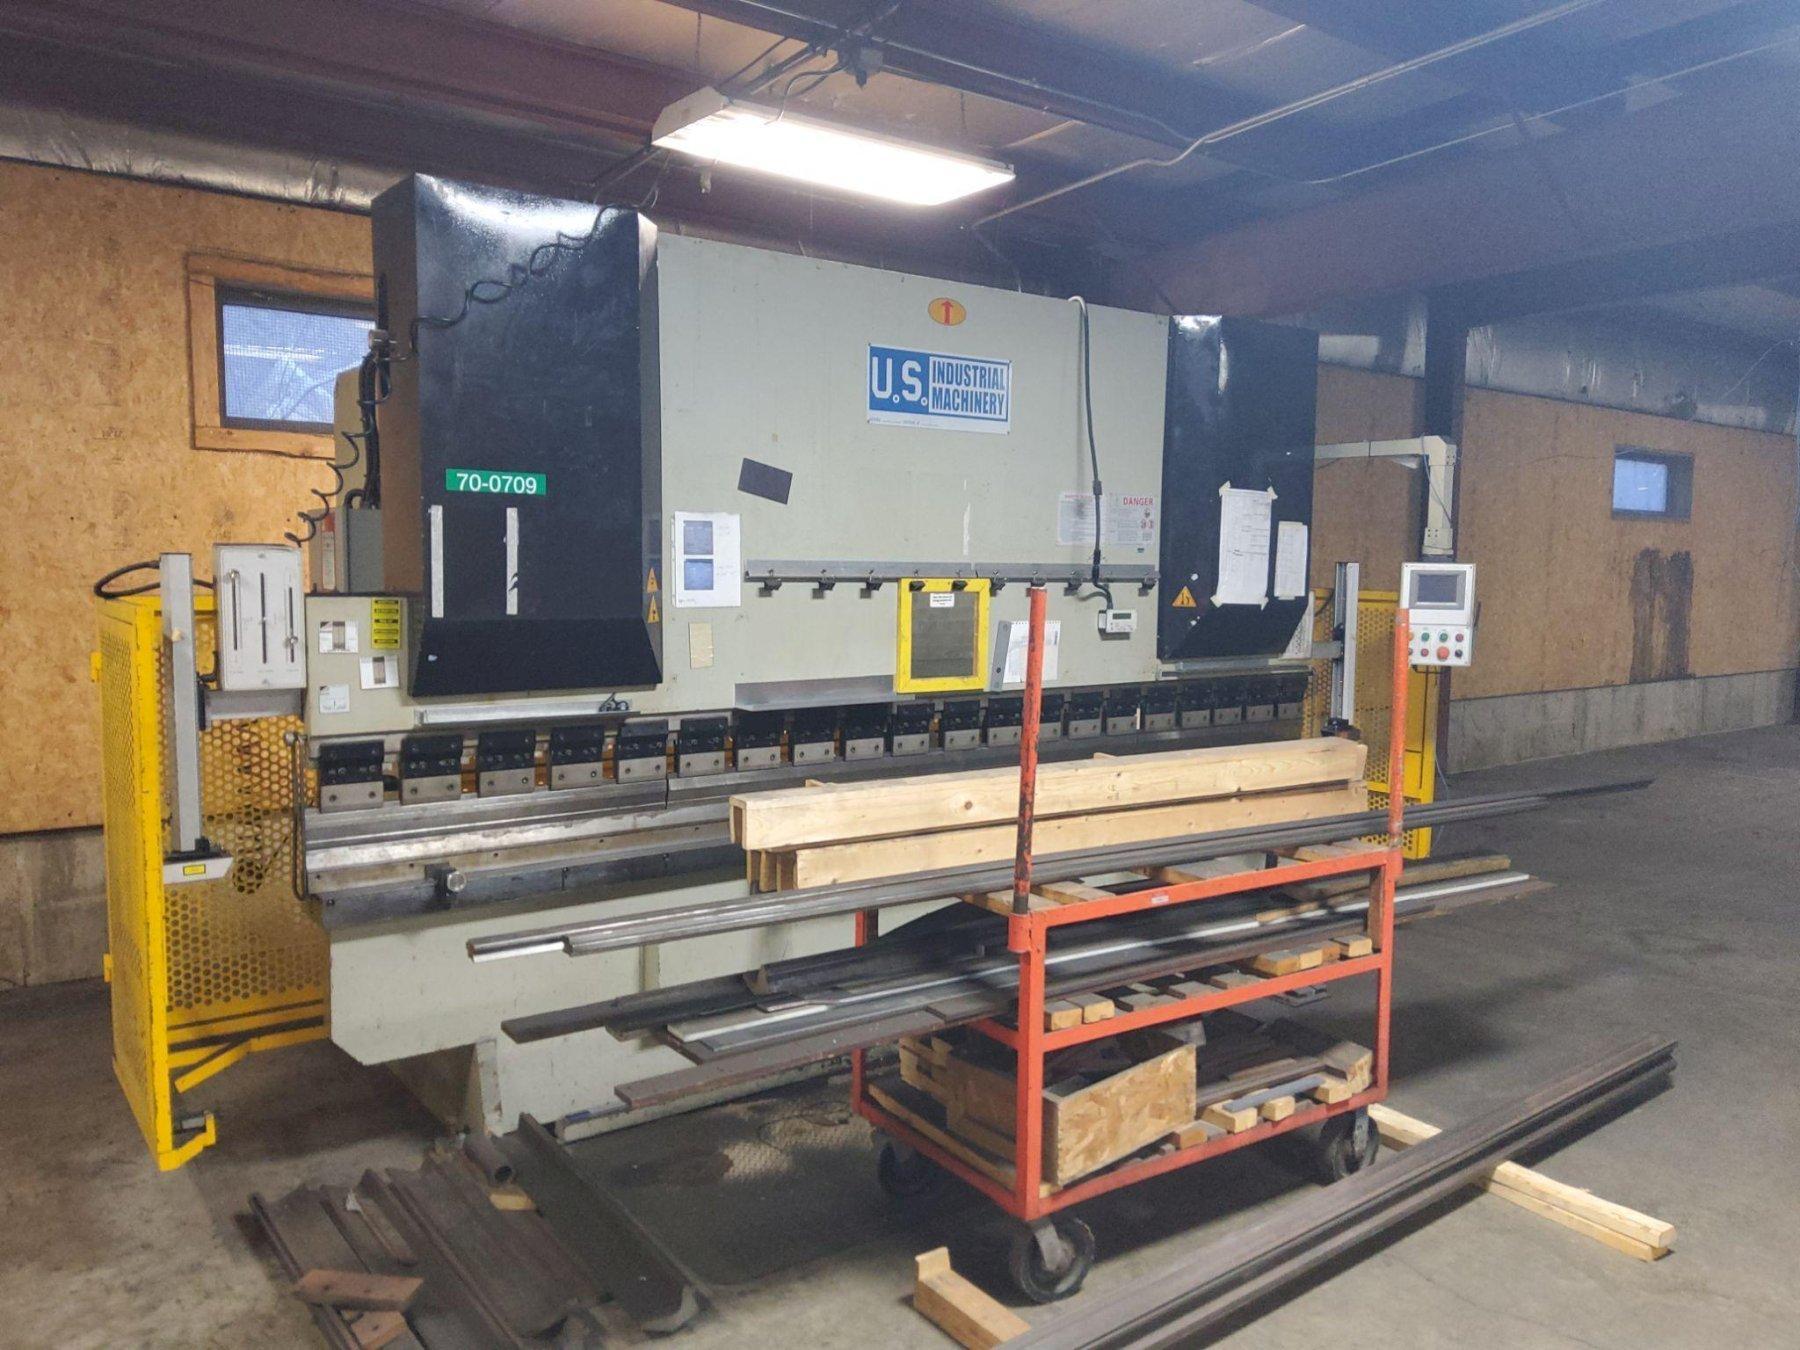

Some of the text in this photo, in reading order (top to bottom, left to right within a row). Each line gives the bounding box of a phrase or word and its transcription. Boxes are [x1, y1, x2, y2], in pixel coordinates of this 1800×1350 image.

[872, 356, 928, 406] U.S.
[932, 360, 1005, 390] INDUSTRIAL
[932, 387, 1005, 415] MACHINERY
[457, 473, 537, 494] 70-0709
[1123, 496, 1153, 505] DANGER
